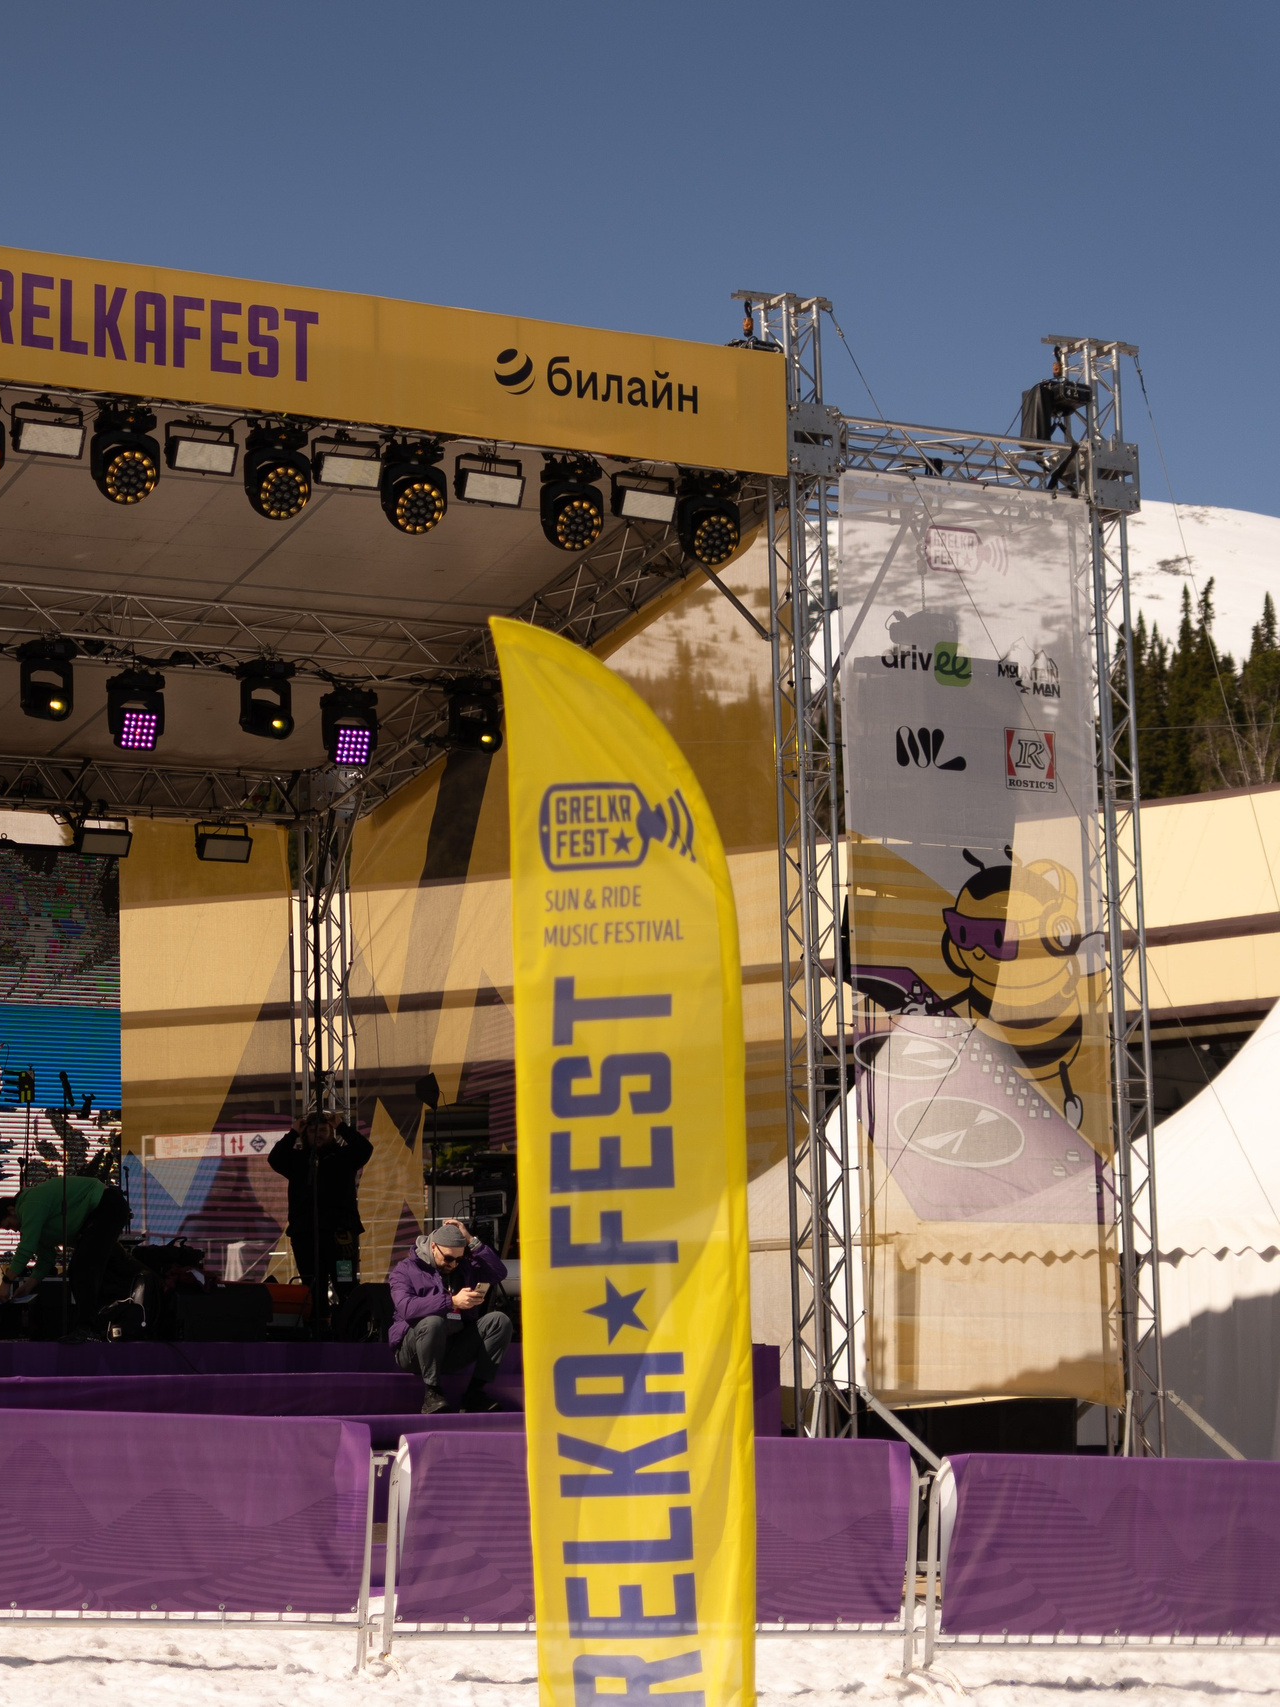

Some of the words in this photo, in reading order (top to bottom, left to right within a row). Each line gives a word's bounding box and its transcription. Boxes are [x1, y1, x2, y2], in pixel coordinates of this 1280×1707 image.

[547, 356, 698, 414] билайн
[933, 532, 975, 550] GRELKA
[933, 551, 960, 566] FEST
[881, 644, 972, 680] drivee
[1033, 683, 1060, 698] MAN
[1008, 778, 1055, 790] ROSTIC'S
[554, 794, 632, 825] GRELKA
[556, 828, 609, 858] FEST
[545, 887, 579, 912] SUN
[583, 888, 597, 910] &
[601, 885, 642, 909] RIDE
[544, 922, 599, 948] MUSIC
[604, 919, 684, 945] FESTIVAL
[550, 977, 679, 1268] FEST
